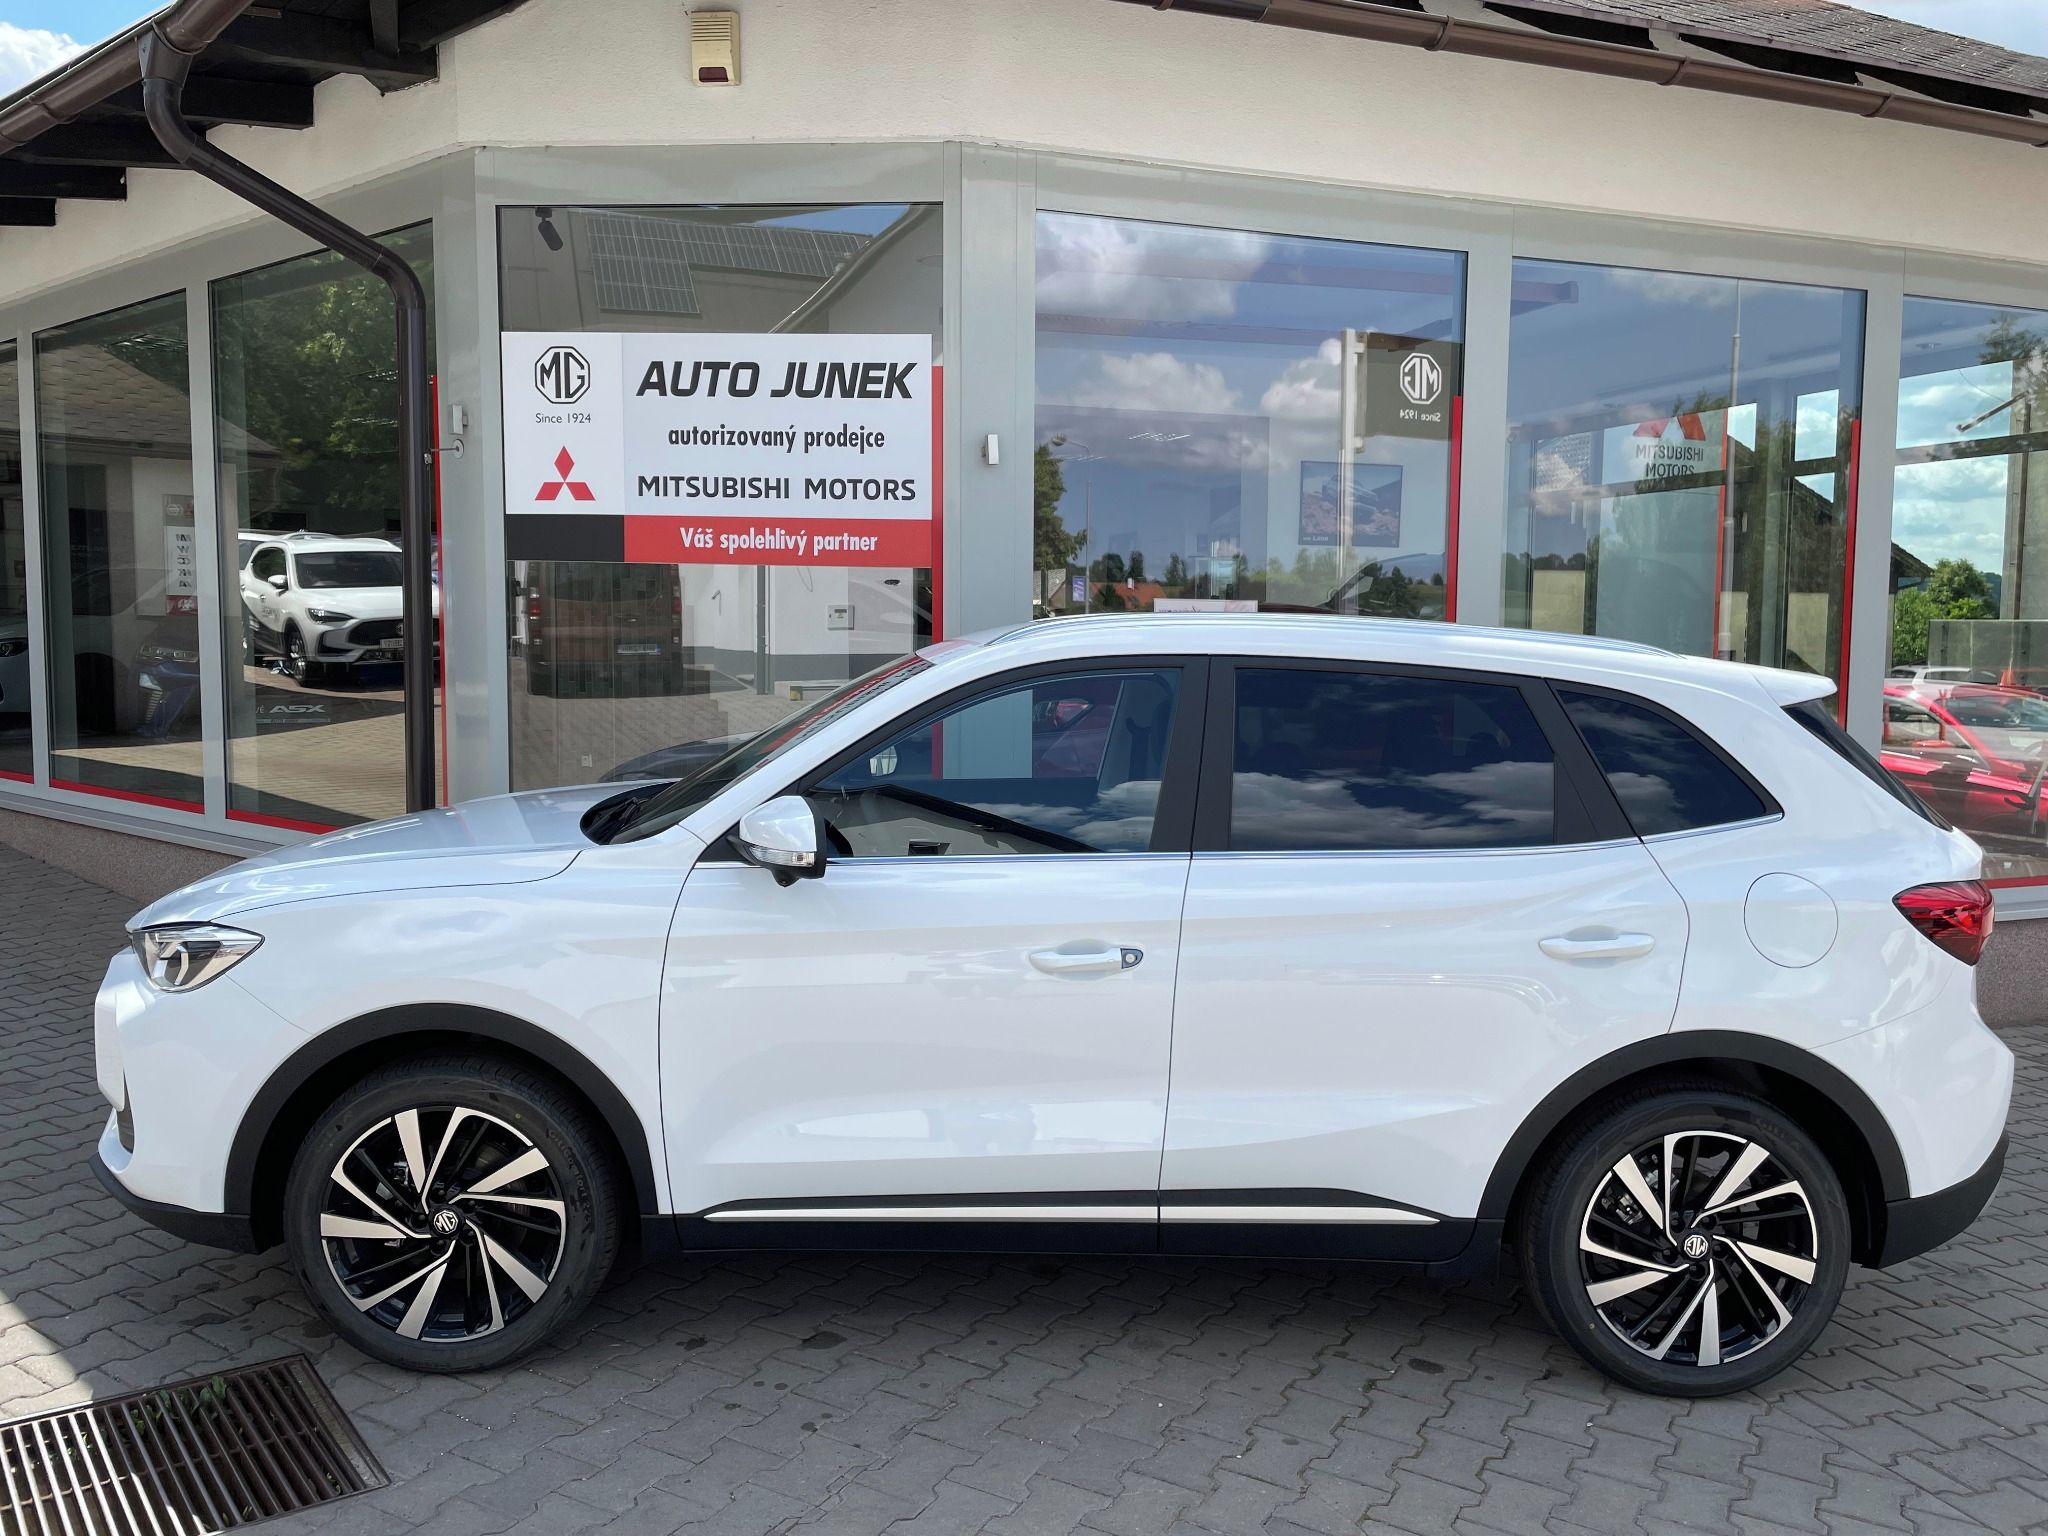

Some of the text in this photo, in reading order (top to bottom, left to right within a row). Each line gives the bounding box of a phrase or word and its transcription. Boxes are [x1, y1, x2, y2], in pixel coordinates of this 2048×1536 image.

[539, 351, 586, 399] MG
[635, 360, 918, 399] AUTO JUNEK
[535, 412, 592, 424] Since 1924
[668, 423, 885, 455] autorizovaný prodejce
[1635, 444, 1704, 462] MITSUBISHI
[1645, 461, 1695, 478] MOTORS
[638, 475, 916, 501] MITSUBISHI MOTORS
[679, 527, 878, 556] Váš spolehlivý partner
[268, 704, 326, 714] ASX
[435, 1212, 457, 1232] MG
[1685, 1236, 1707, 1257] MG
